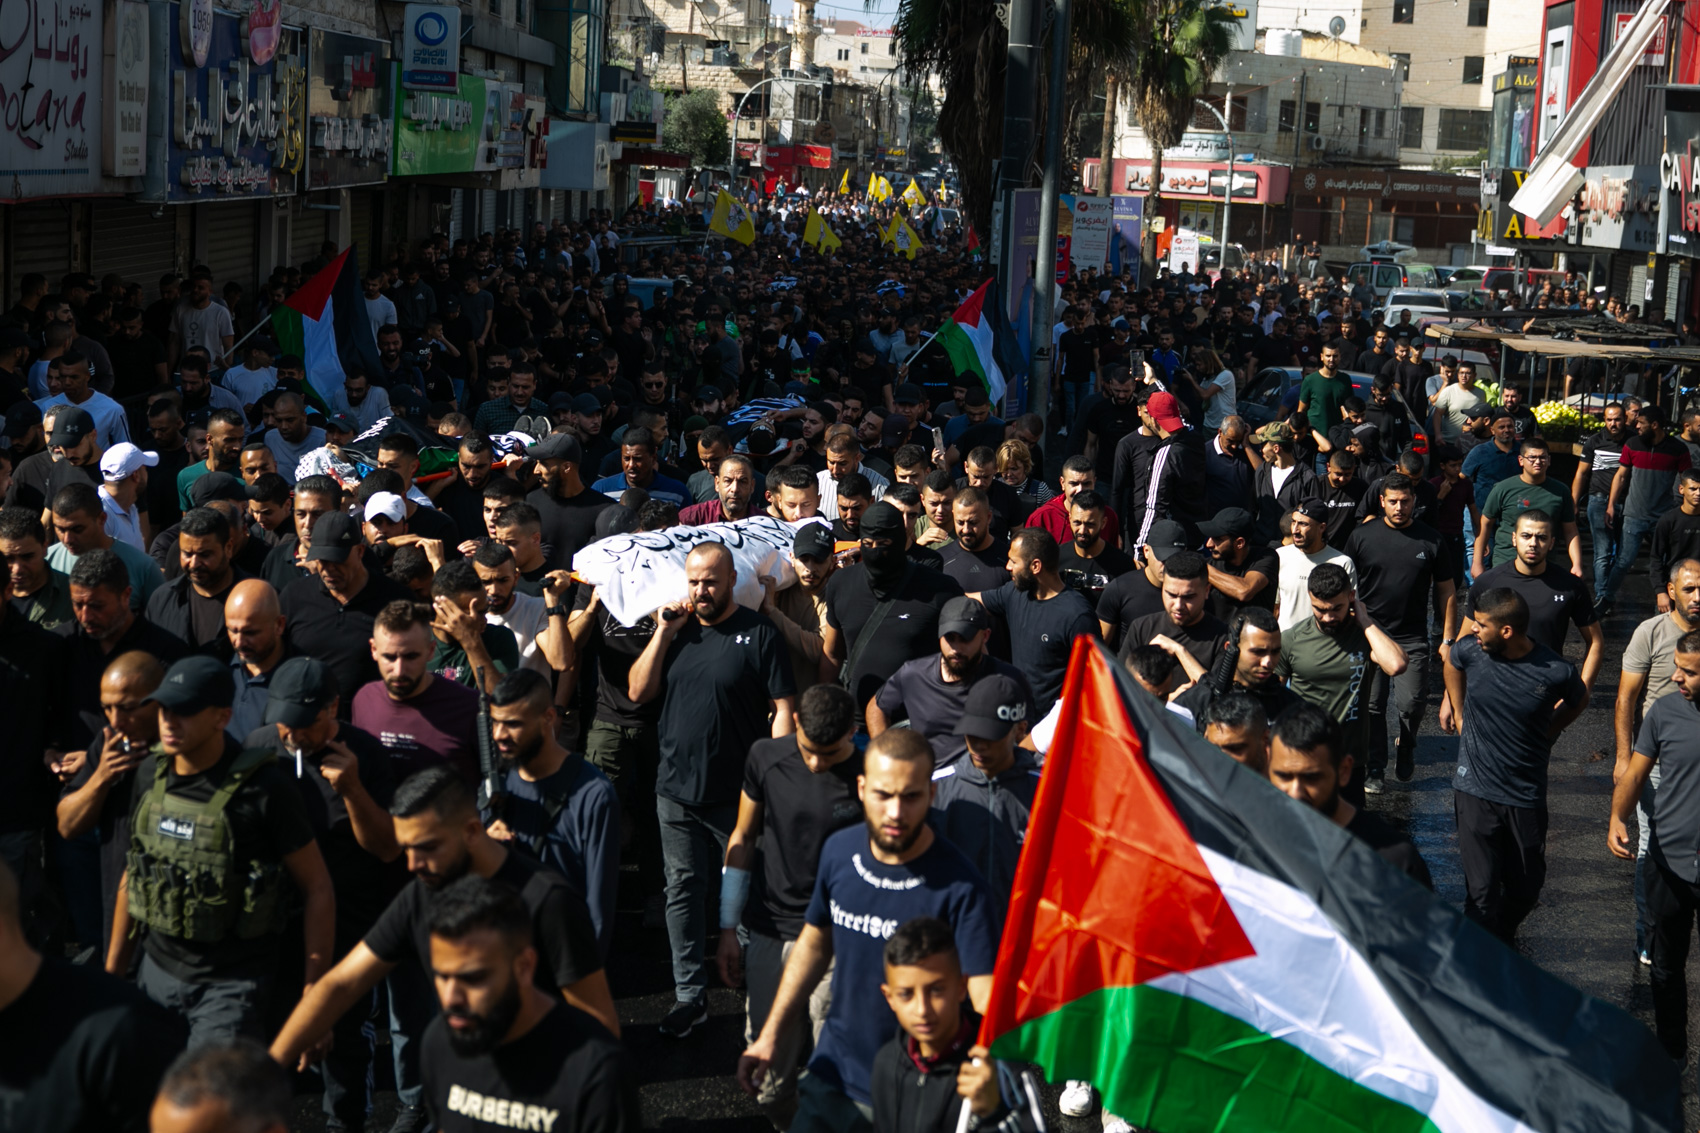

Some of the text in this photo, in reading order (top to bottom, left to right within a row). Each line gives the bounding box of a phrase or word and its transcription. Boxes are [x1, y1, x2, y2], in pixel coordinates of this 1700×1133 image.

[192, 9, 211, 33] 1959
[413, 55, 448, 65] Paltel
[64, 138, 88, 162] Studio
[1169, 175, 1207, 190] ستوديو
[447, 1083, 560, 1133] BURBERRY
